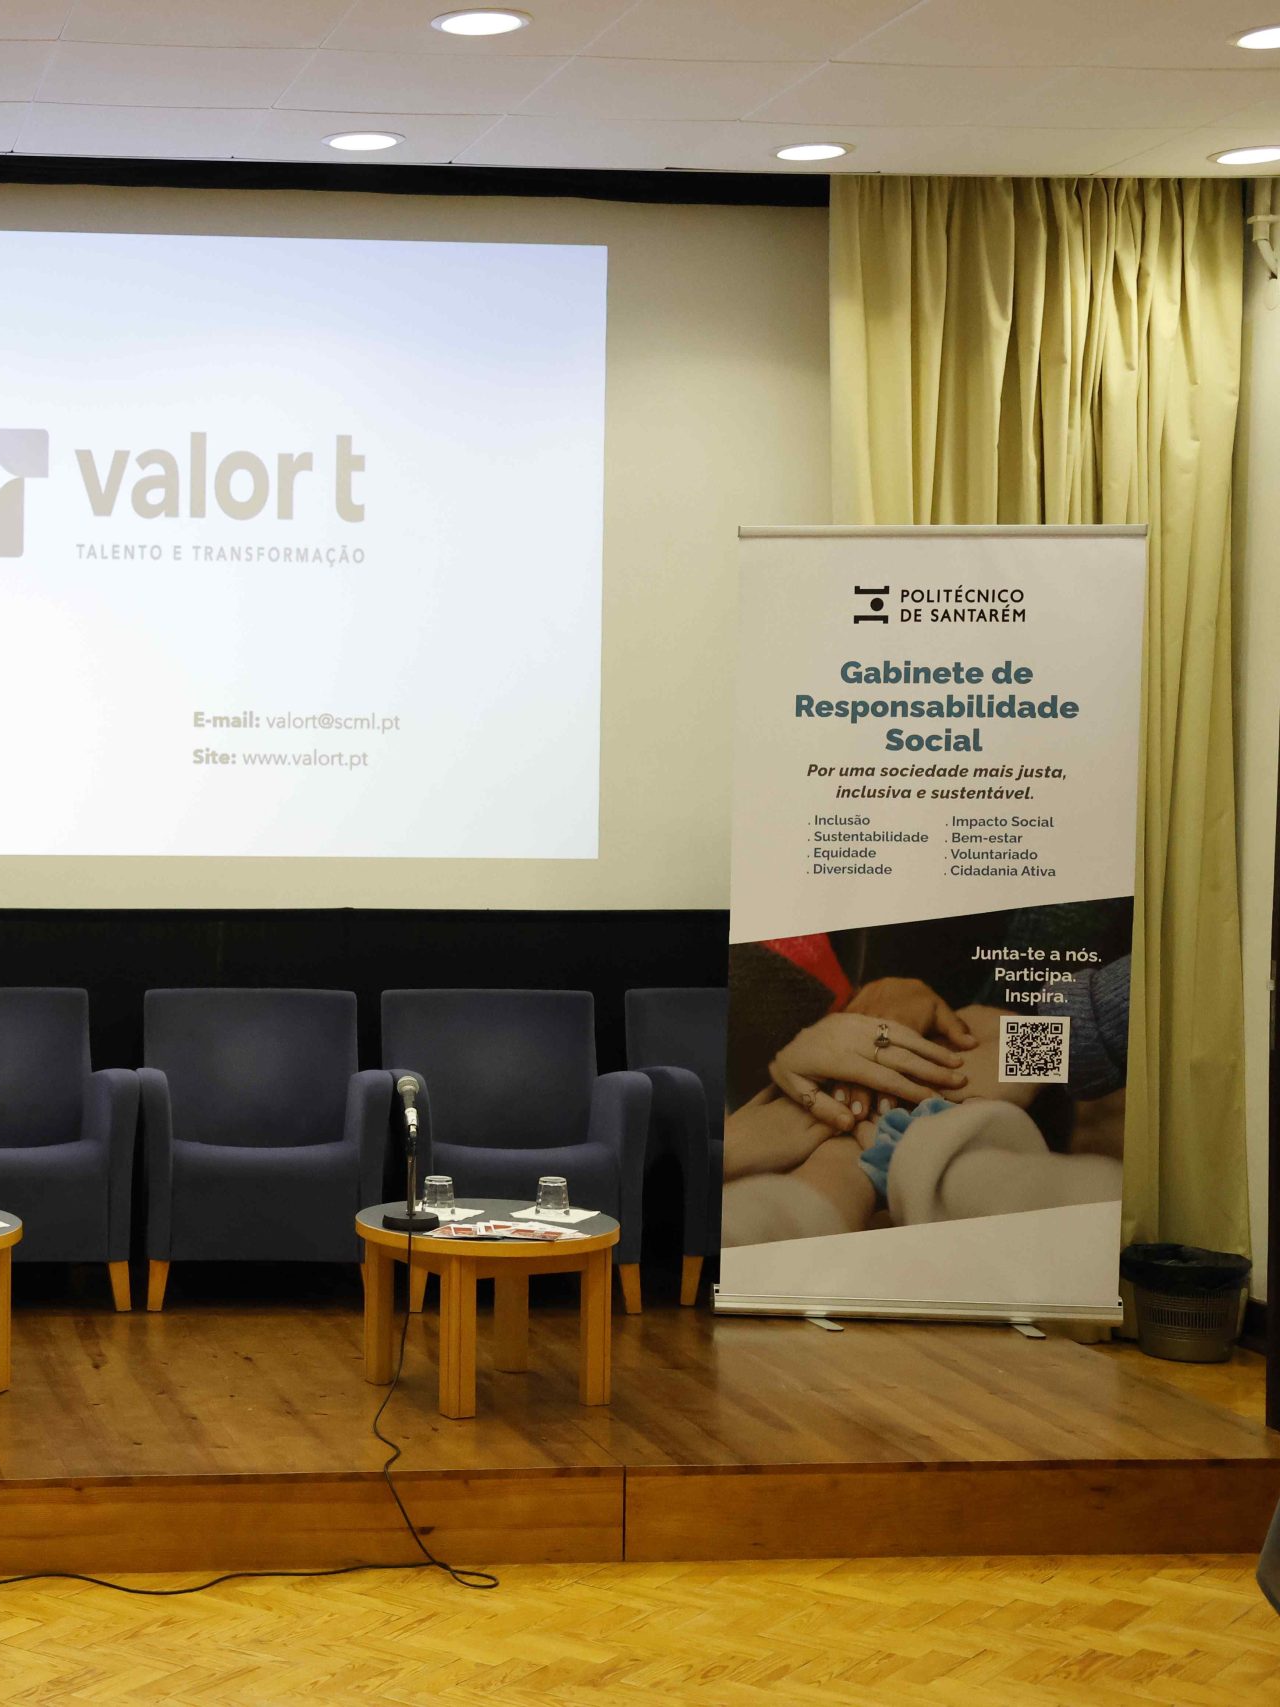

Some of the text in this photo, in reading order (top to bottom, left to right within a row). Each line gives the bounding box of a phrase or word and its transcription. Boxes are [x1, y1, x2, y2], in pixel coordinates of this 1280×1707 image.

[75, 432, 313, 521] valor
[76, 544, 365, 568] TALENTO E TRANSFORMAÇÃO
[901, 585, 1024, 604] POLITÉCNICO
[901, 603, 1025, 622] DE SANTARÉM
[841, 661, 1033, 684] Gabinete de
[796, 694, 1079, 724] Responsabilidade
[194, 711, 400, 734] E-mail: valort@scml.pt
[885, 728, 983, 752] Social
[193, 747, 368, 771] Site: www.valort.pt
[807, 764, 1066, 781] Por uma sociedade mais justa,
[836, 785, 1033, 799] inclusiva e sustentável.
[953, 816, 1054, 829] Impacto Social
[814, 831, 928, 842] Sustentabilidade
[952, 833, 1023, 843] Bem-estar
[814, 847, 876, 860] Equidade
[951, 849, 1038, 860] Voluntariado
[814, 864, 892, 874] Diversidade
[951, 865, 1056, 876] Cidadania Ativa
[972, 946, 1101, 962] Junta-te a nós.
[995, 968, 1076, 985] Participa.
[1006, 988, 1069, 1006] Inspira.
